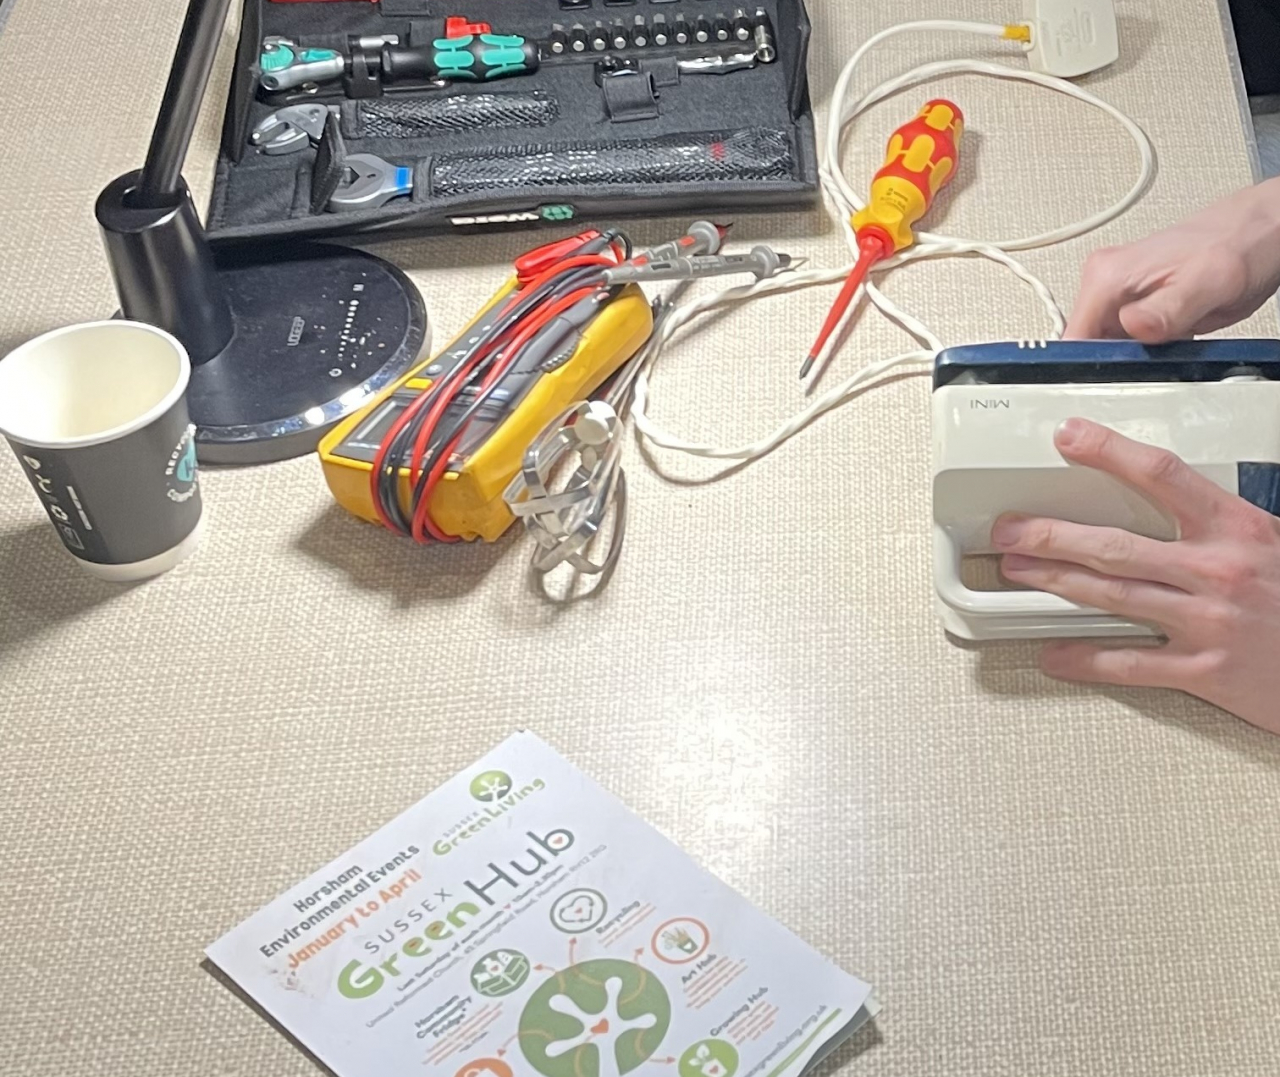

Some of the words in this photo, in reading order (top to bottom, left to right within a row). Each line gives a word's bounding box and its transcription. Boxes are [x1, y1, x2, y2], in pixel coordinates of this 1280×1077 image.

[970, 399, 1009, 409] MINI
[259, 878, 370, 958] Environmental
[366, 846, 420, 883] Events
[288, 914, 358, 972] January
[355, 901, 380, 917] to
[379, 869, 422, 904] April
[293, 866, 362, 912] Horsham
[364, 888, 452, 954] SUSSEX
